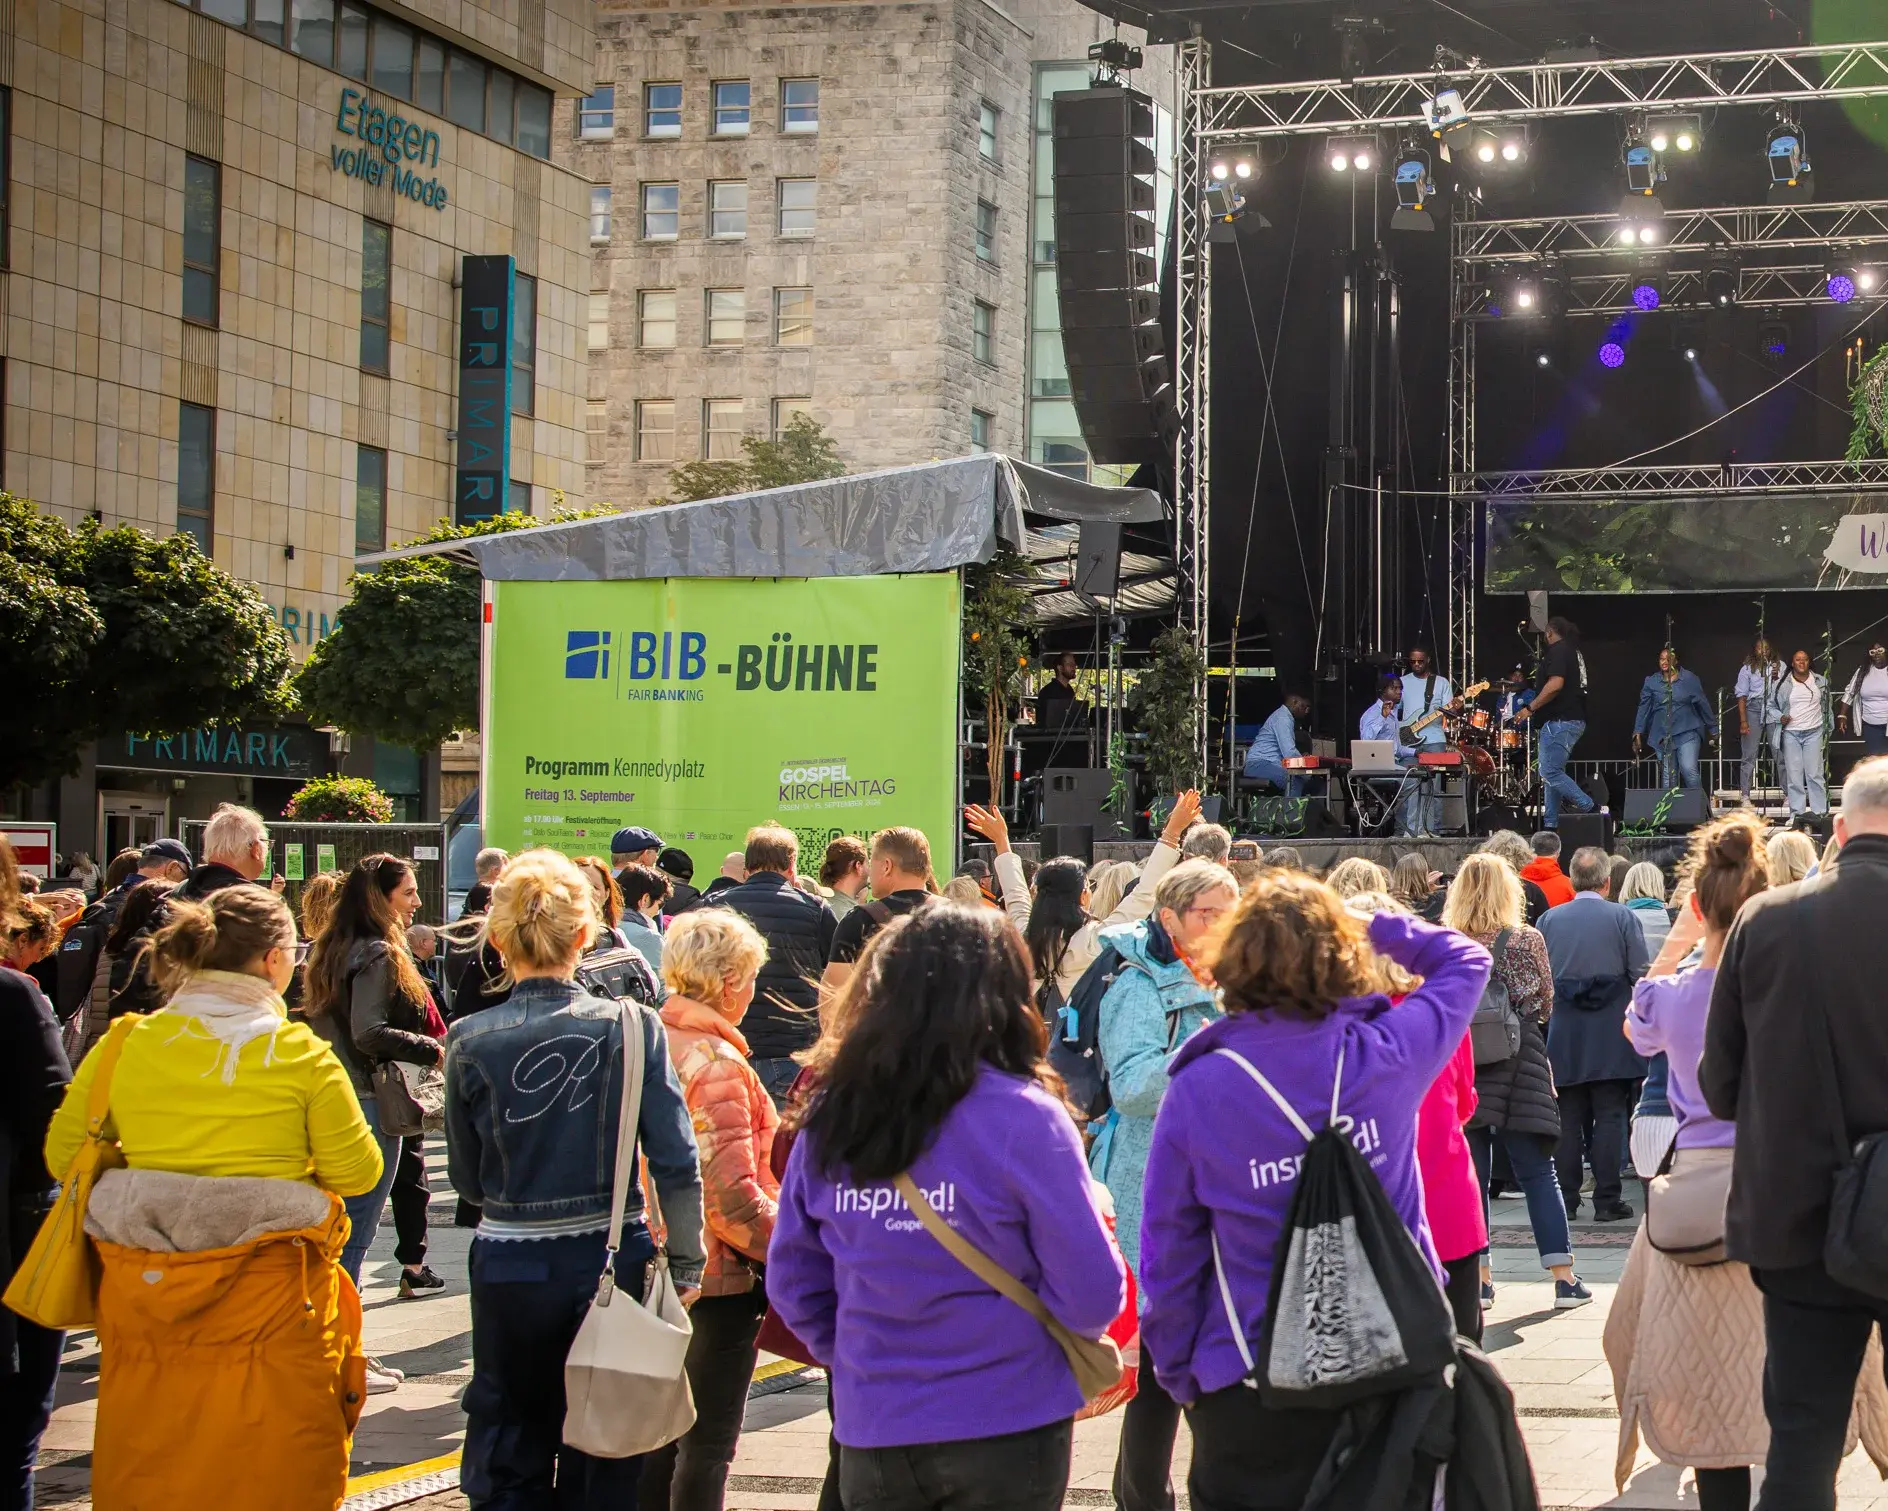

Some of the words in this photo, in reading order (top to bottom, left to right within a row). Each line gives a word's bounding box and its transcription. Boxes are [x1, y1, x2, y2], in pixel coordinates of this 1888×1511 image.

[337, 87, 441, 168] Etagen
[331, 144, 391, 188] voller
[391, 163, 449, 212] Mode
[629, 631, 707, 680] BIB
[525, 755, 610, 781] Programm
[613, 757, 705, 783] Kennedyplatz
[779, 764, 852, 785] GOSPEL
[524, 788, 560, 803] Freitag
[562, 789, 577, 801] 13.
[580, 789, 635, 804] September
[778, 778, 897, 802] KIRCHENTAG
[834, 1180, 956, 1220] inspid!
